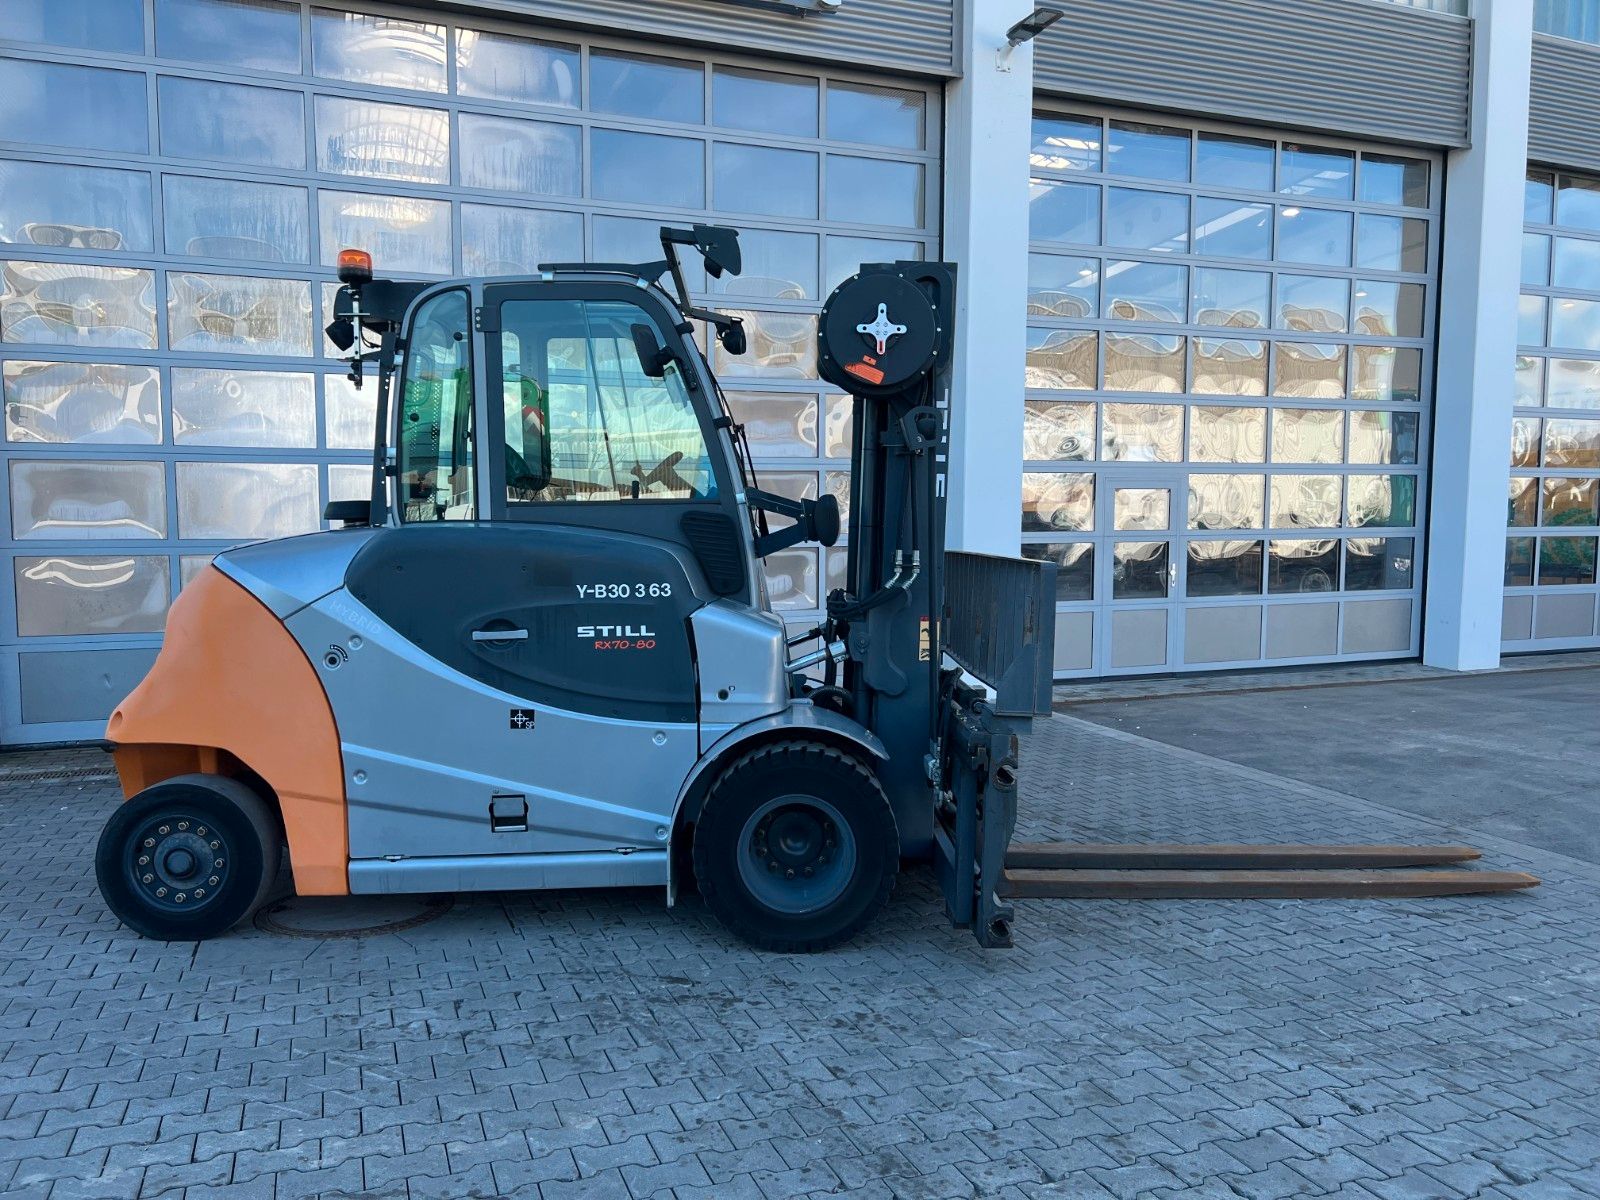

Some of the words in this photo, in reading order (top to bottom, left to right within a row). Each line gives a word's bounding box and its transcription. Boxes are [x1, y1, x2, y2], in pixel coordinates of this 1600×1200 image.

[576, 583, 630, 599] Y-B30
[577, 625, 656, 638] STILL
[594, 639, 656, 650] RX70-80
